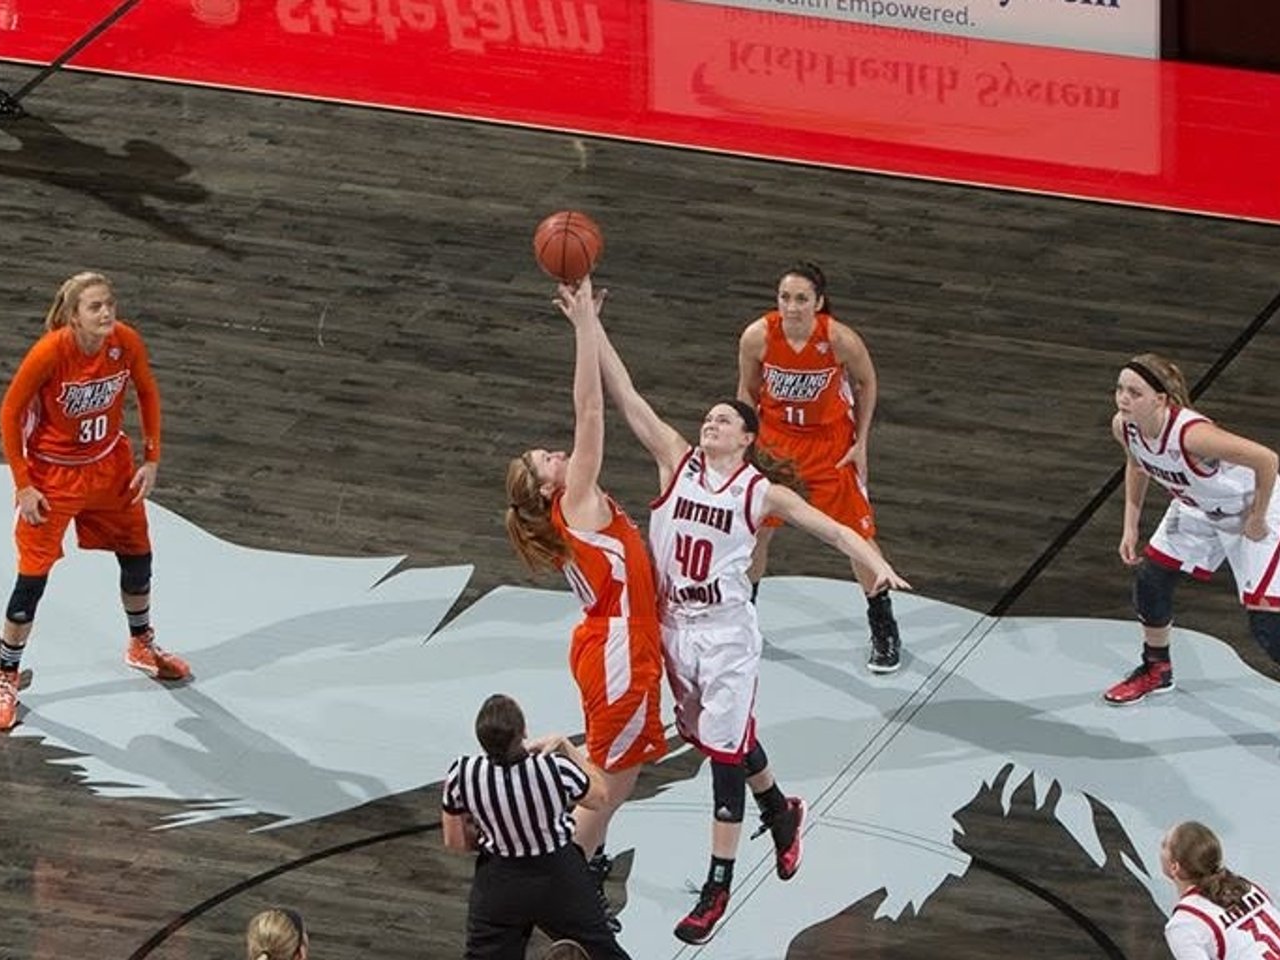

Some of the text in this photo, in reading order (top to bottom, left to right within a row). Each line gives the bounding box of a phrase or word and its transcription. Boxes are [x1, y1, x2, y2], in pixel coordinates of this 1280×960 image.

[767, 368, 829, 389] BOWLING
[79, 415, 107, 443] 30
[785, 406, 805, 426] 11
[673, 496, 733, 535] NORTHERN
[675, 533, 713, 583] 40
